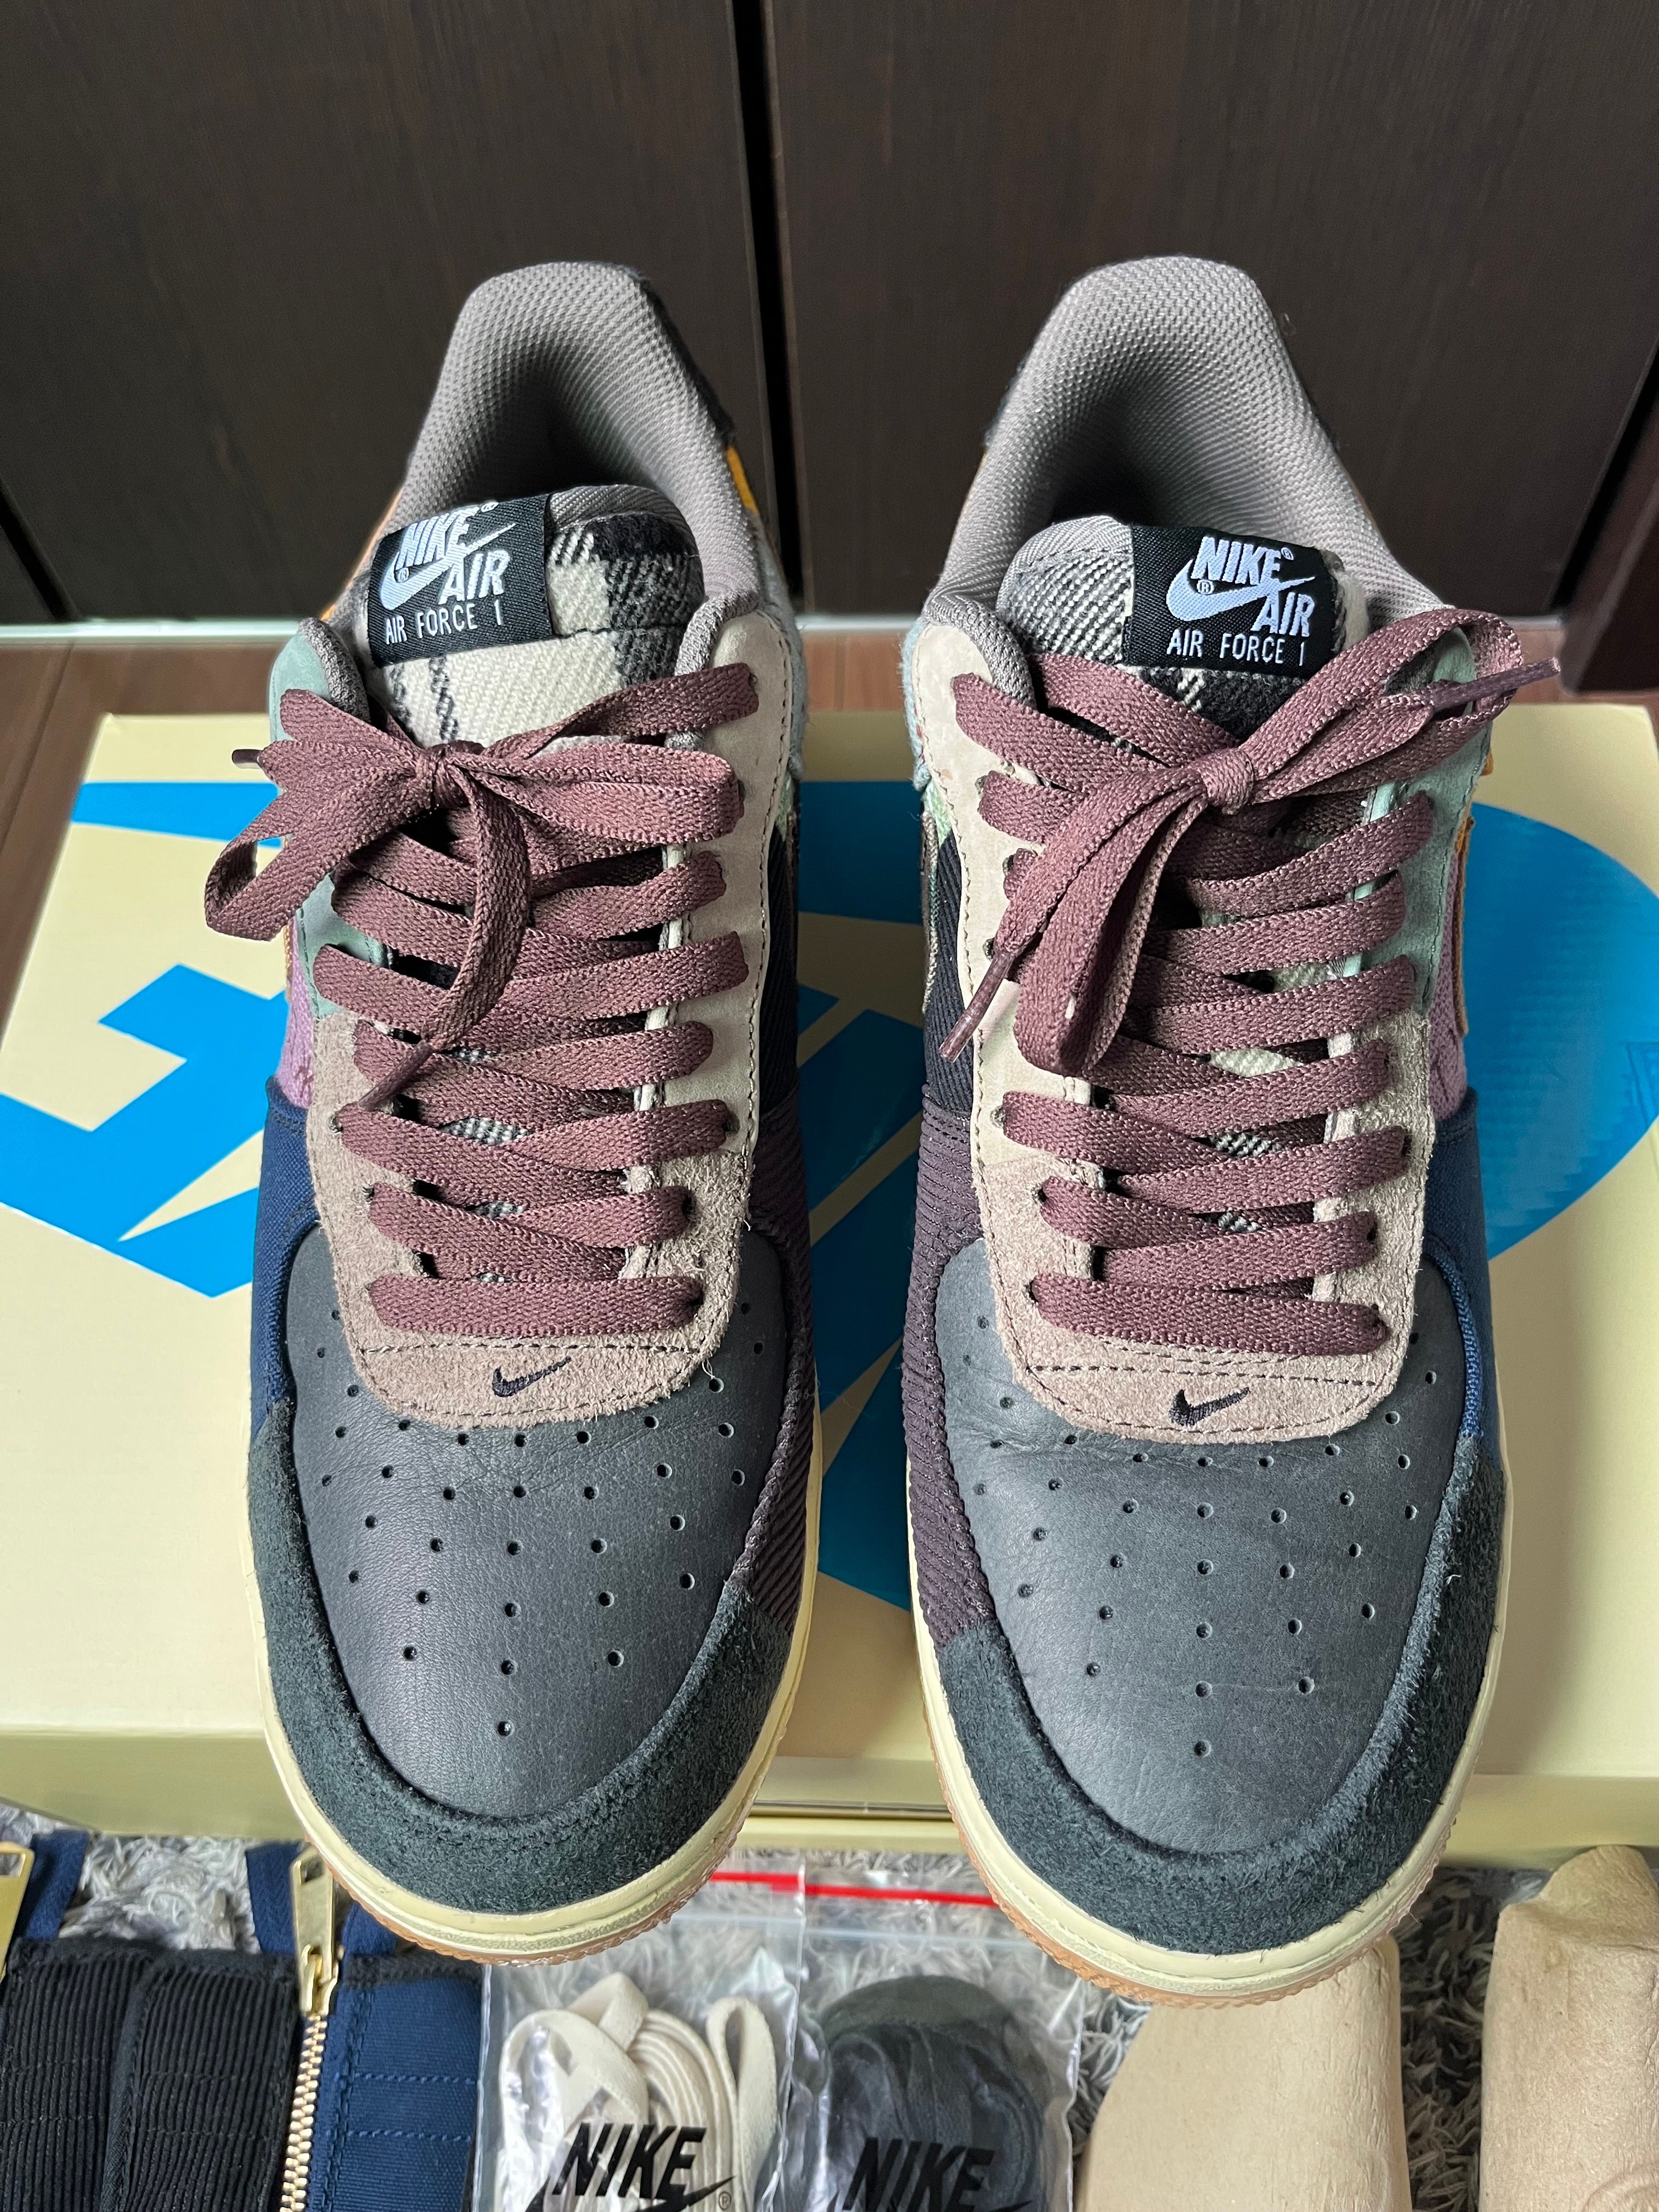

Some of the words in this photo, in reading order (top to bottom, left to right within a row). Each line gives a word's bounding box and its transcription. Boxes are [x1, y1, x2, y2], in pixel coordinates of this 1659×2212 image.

[394, 505, 481, 571] NIKE
[1190, 536, 1282, 586] NIKE
[438, 549, 510, 605] AIR
[385, 614, 408, 645] AIR
[415, 603, 478, 639] FORCE
[1250, 590, 1315, 637] AIR
[1166, 628, 1204, 658] AIR
[1219, 633, 1286, 665] FORCE
[551, 2122, 707, 2201] NIKE
[842, 2136, 996, 2212] NIKE
